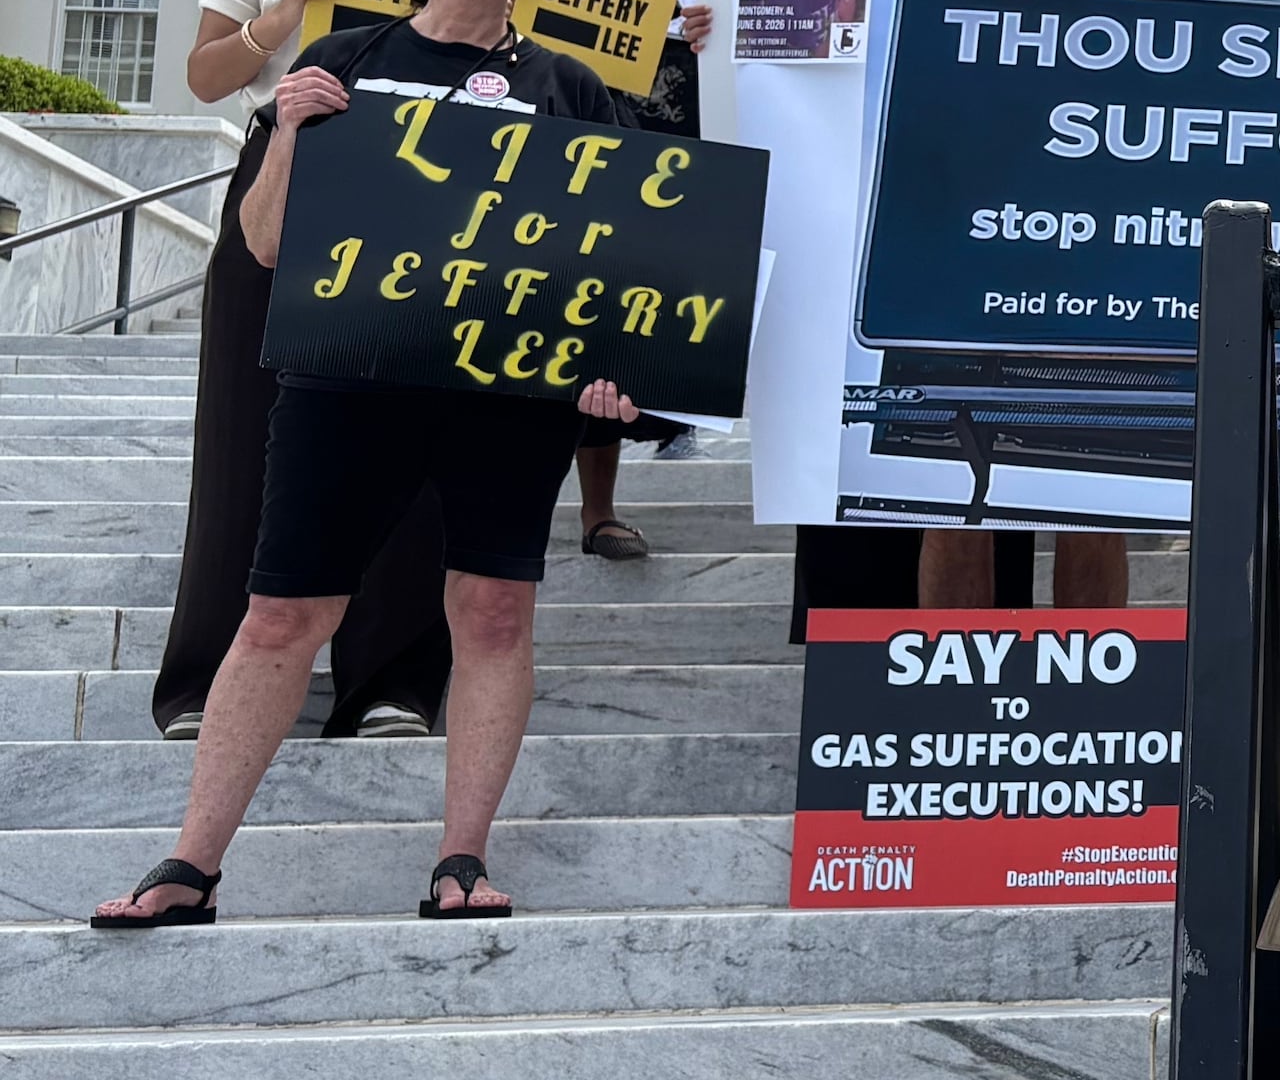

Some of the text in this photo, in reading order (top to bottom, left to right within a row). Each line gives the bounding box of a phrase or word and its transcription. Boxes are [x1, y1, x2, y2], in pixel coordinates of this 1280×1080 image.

[765, 20, 785, 30] 2026
[944, 9, 1193, 74] THOU
[600, 27, 642, 62] LEE
[394, 98, 691, 208] LIFE
[450, 190, 613, 255] for
[969, 203, 1097, 250] stop
[313, 237, 725, 343] JEFFERY
[984, 292, 1200, 321] Paid for by The
[453, 318, 585, 386] LEE
[888, 632, 1137, 685] SAY NO
[991, 697, 1029, 720] TO
[811, 733, 898, 768] GAS
[866, 780, 1145, 817] EXECUTIONS!
[817, 845, 915, 855] DEATH PENALTY
[808, 855, 914, 891] ACTION
